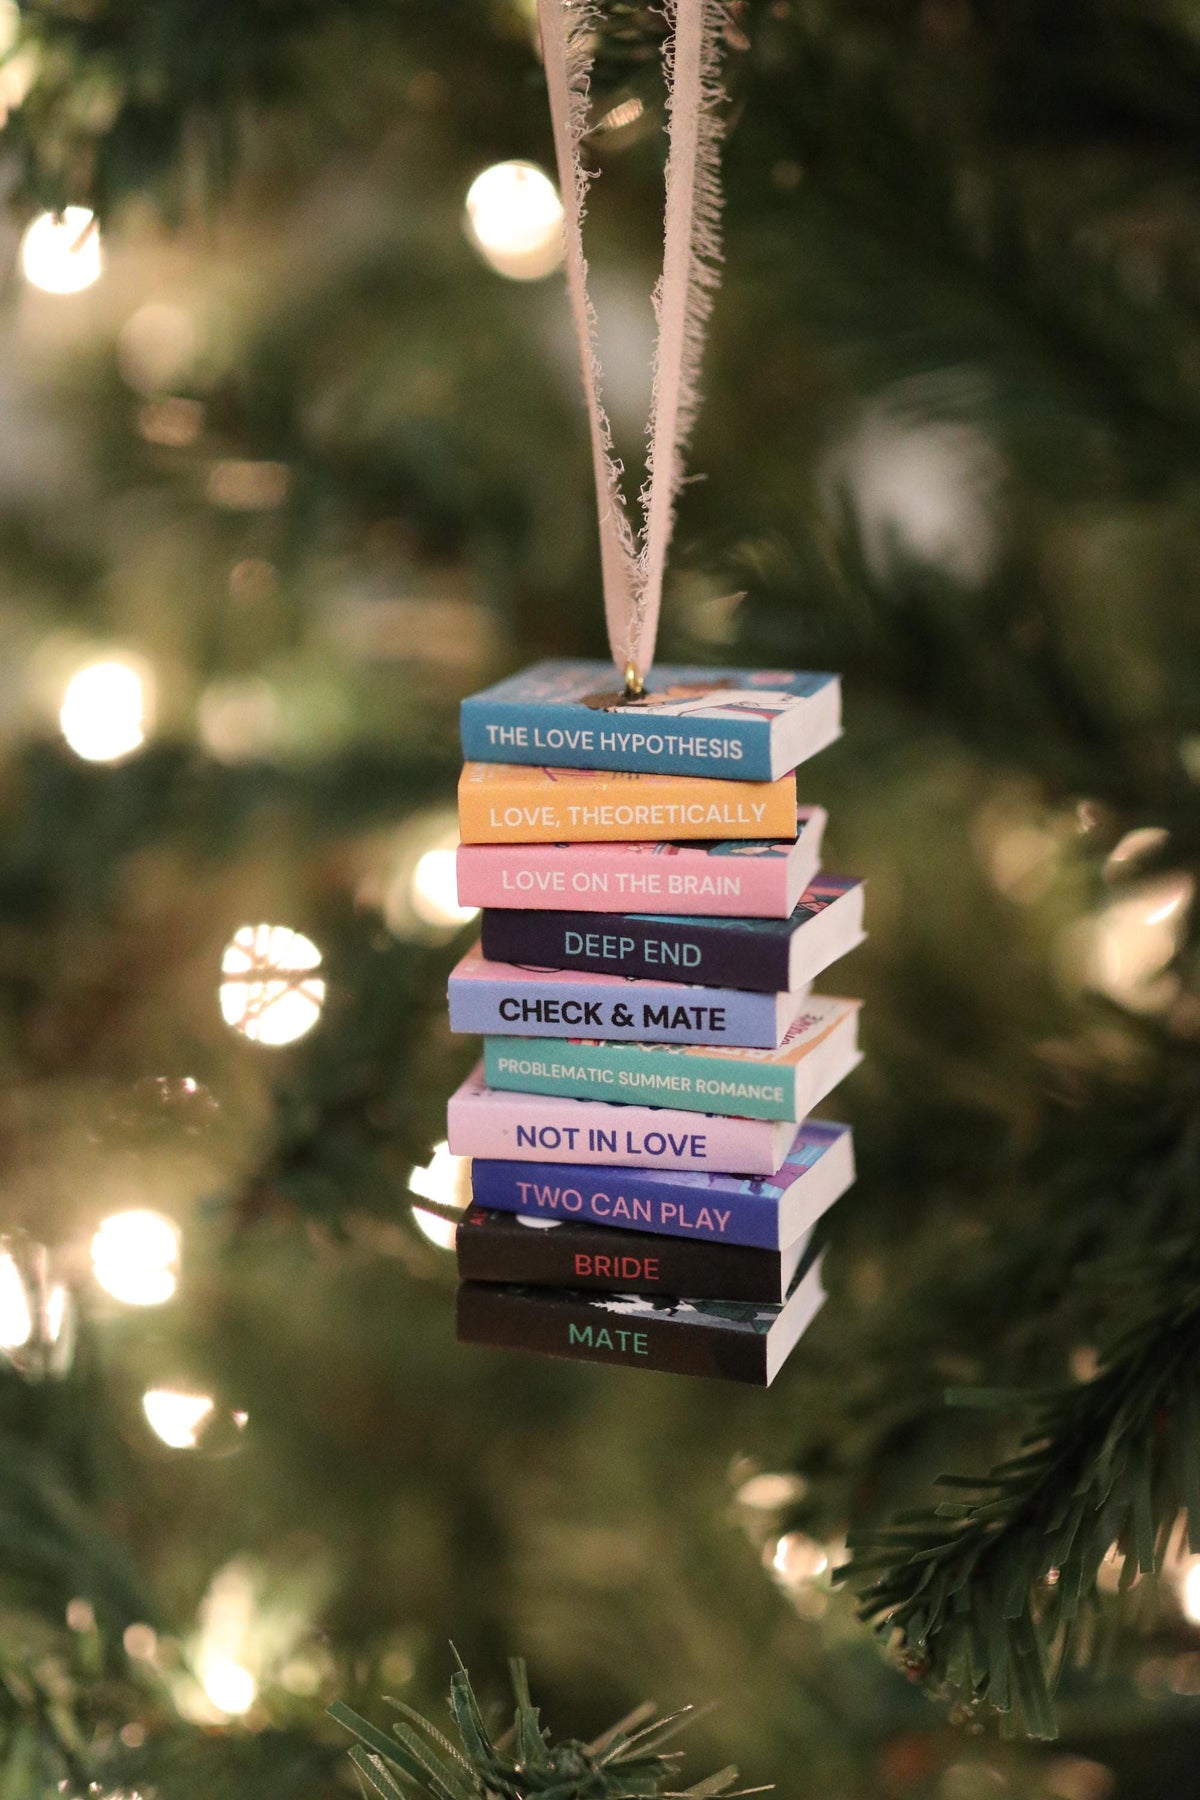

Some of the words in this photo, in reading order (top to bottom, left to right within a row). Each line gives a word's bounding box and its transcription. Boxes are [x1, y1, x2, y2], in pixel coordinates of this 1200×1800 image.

[486, 724, 529, 746] THE
[534, 728, 593, 750] LOVE
[600, 731, 743, 759] HYPOTHESIS
[490, 806, 560, 829] LOVE,
[567, 803, 767, 826] THEORETICALLY
[502, 870, 566, 891] LOVE
[572, 871, 608, 893] ON
[614, 873, 661, 894] THE
[668, 875, 741, 896] BRAIN
[565, 930, 635, 961] DEEP
[644, 940, 701, 967] END
[499, 997, 603, 1027] CHECK
[610, 1002, 634, 1029] &
[643, 1005, 726, 1032] MATE
[498, 1058, 614, 1084] PROBLEMATIC
[618, 1072, 690, 1092] SUMMER
[697, 1081, 784, 1102] ROMANCE
[516, 1125, 580, 1151] NOT
[589, 1129, 617, 1153] IN
[626, 1131, 707, 1158] LOVE
[515, 1182, 583, 1213] TWO
[590, 1193, 652, 1224] CAN
[661, 1203, 732, 1233] PLAY
[574, 1253, 660, 1280] BRIDE
[569, 1323, 649, 1355] MATE
